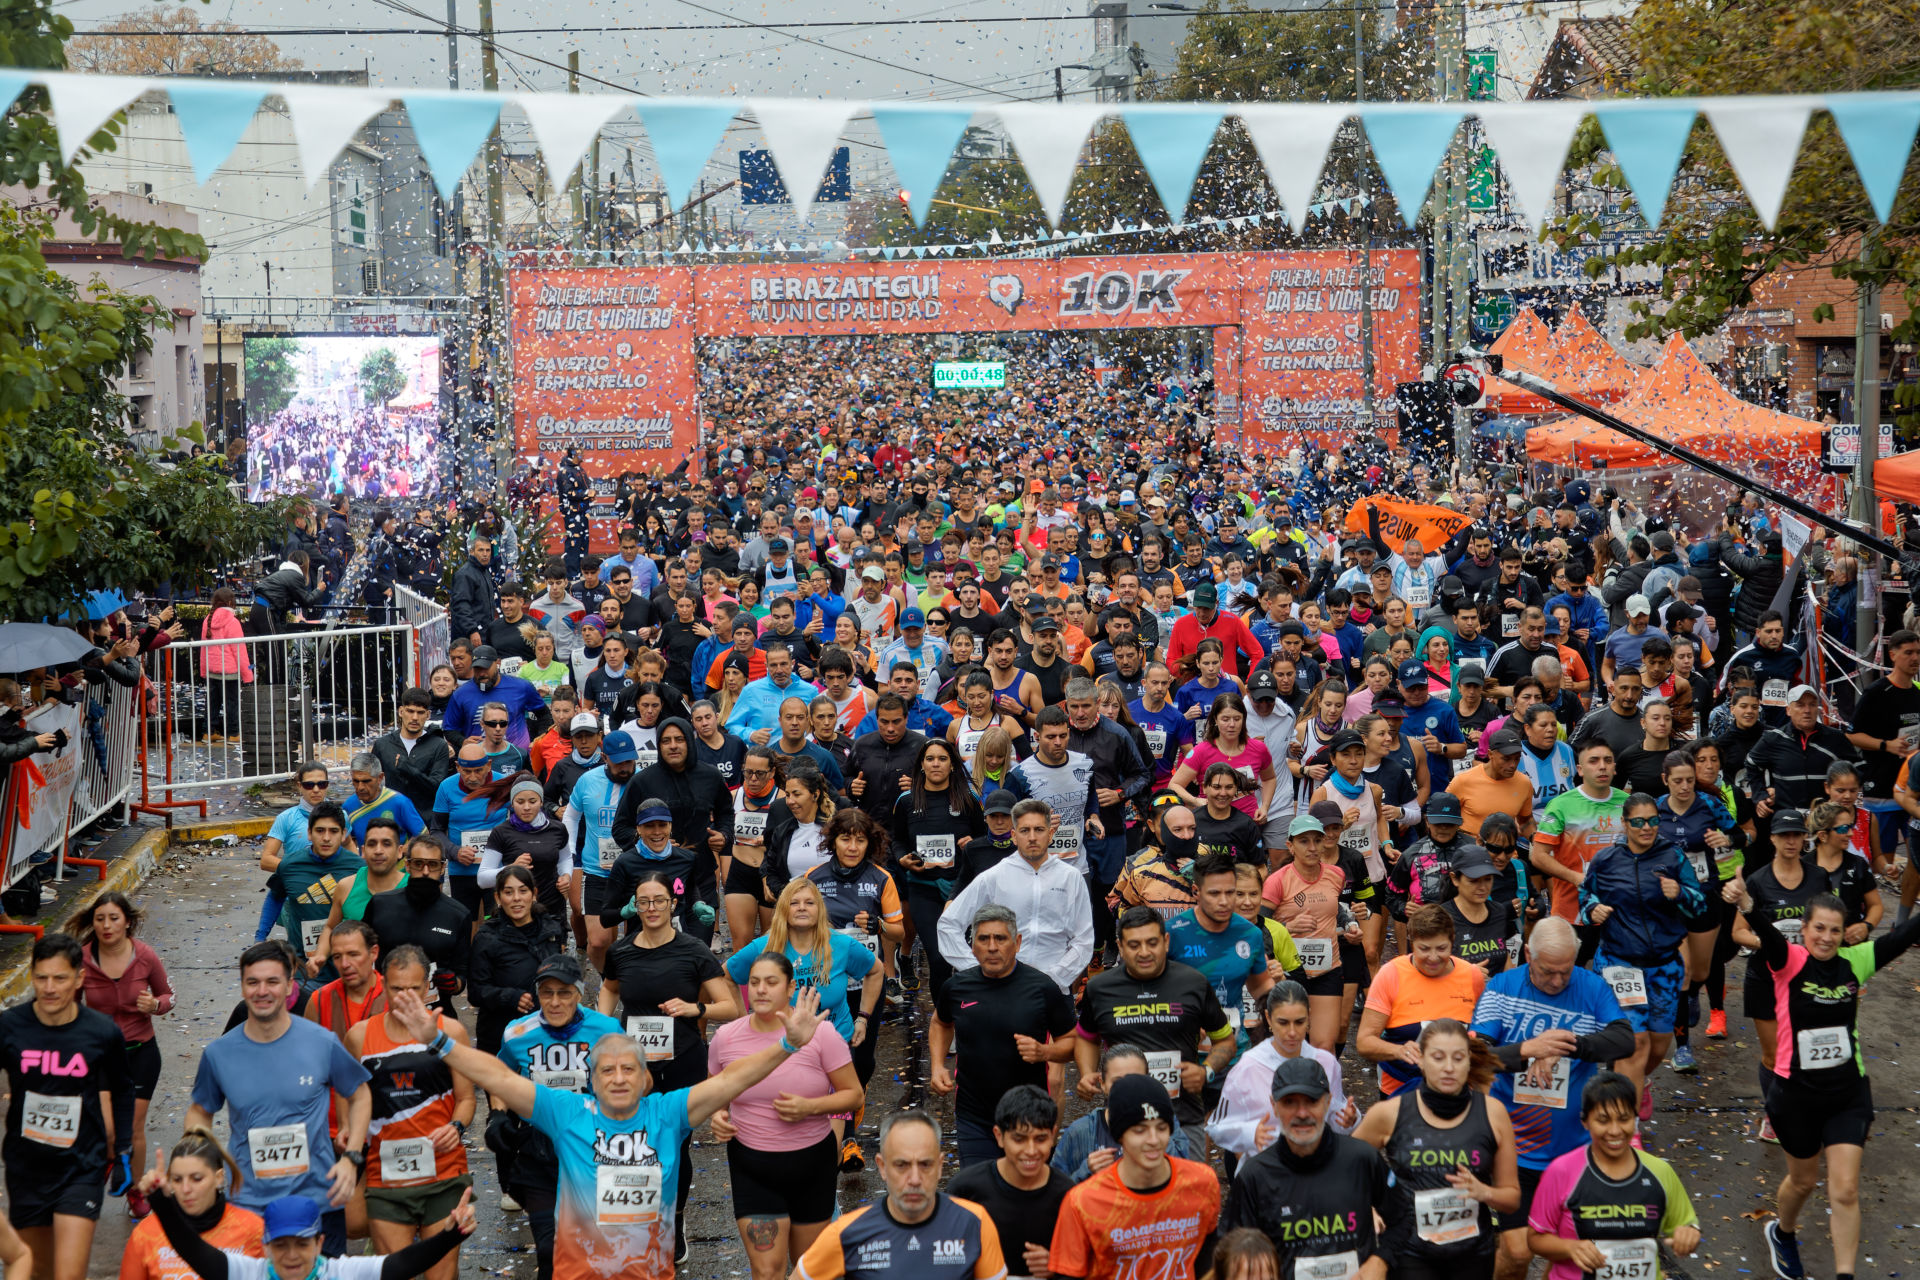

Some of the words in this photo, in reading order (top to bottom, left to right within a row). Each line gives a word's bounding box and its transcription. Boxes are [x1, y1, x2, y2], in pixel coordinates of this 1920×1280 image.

[1269, 269, 1320, 287] PRUEBA
[751, 275, 940, 300] BERAZATEGUI
[1058, 268, 1193, 317] 10K
[1265, 287, 1291, 312] DÍA
[1294, 290, 1323, 312] DEL
[751, 300, 941, 323] MUNICIPALIDAD
[1262, 338, 1338, 353] SAVERIO
[536, 410, 673, 439] Berazategui
[1764, 690, 1787, 699] 3625
[1148, 742, 1163, 751] 99
[1533, 783, 1569, 799] VISA
[736, 824, 766, 836] 2767
[1048, 838, 1078, 849] 2969
[1775, 906, 1806, 919] ZON
[1460, 938, 1505, 957] ZONA5
[1113, 1003, 1183, 1017] ZONA5
[1115, 1014, 1155, 1026] Running
[1155, 1014, 1180, 1023] team
[632, 1034, 670, 1047] 447
[1809, 1046, 1843, 1061] 222
[20, 1050, 89, 1078] FILA
[25, 1111, 74, 1132] 3731
[254, 1144, 303, 1163] 3477
[1410, 1149, 1481, 1166] ZONA5
[397, 1158, 420, 1173] 31
[602, 1189, 658, 1206] 4437
[1579, 1204, 1659, 1220] ZONA5
[1111, 1211, 1201, 1243] Berazategui
[1280, 1211, 1358, 1242] ZONA5
[932, 1238, 966, 1257] 10k
[1600, 1261, 1653, 1280] 3457
